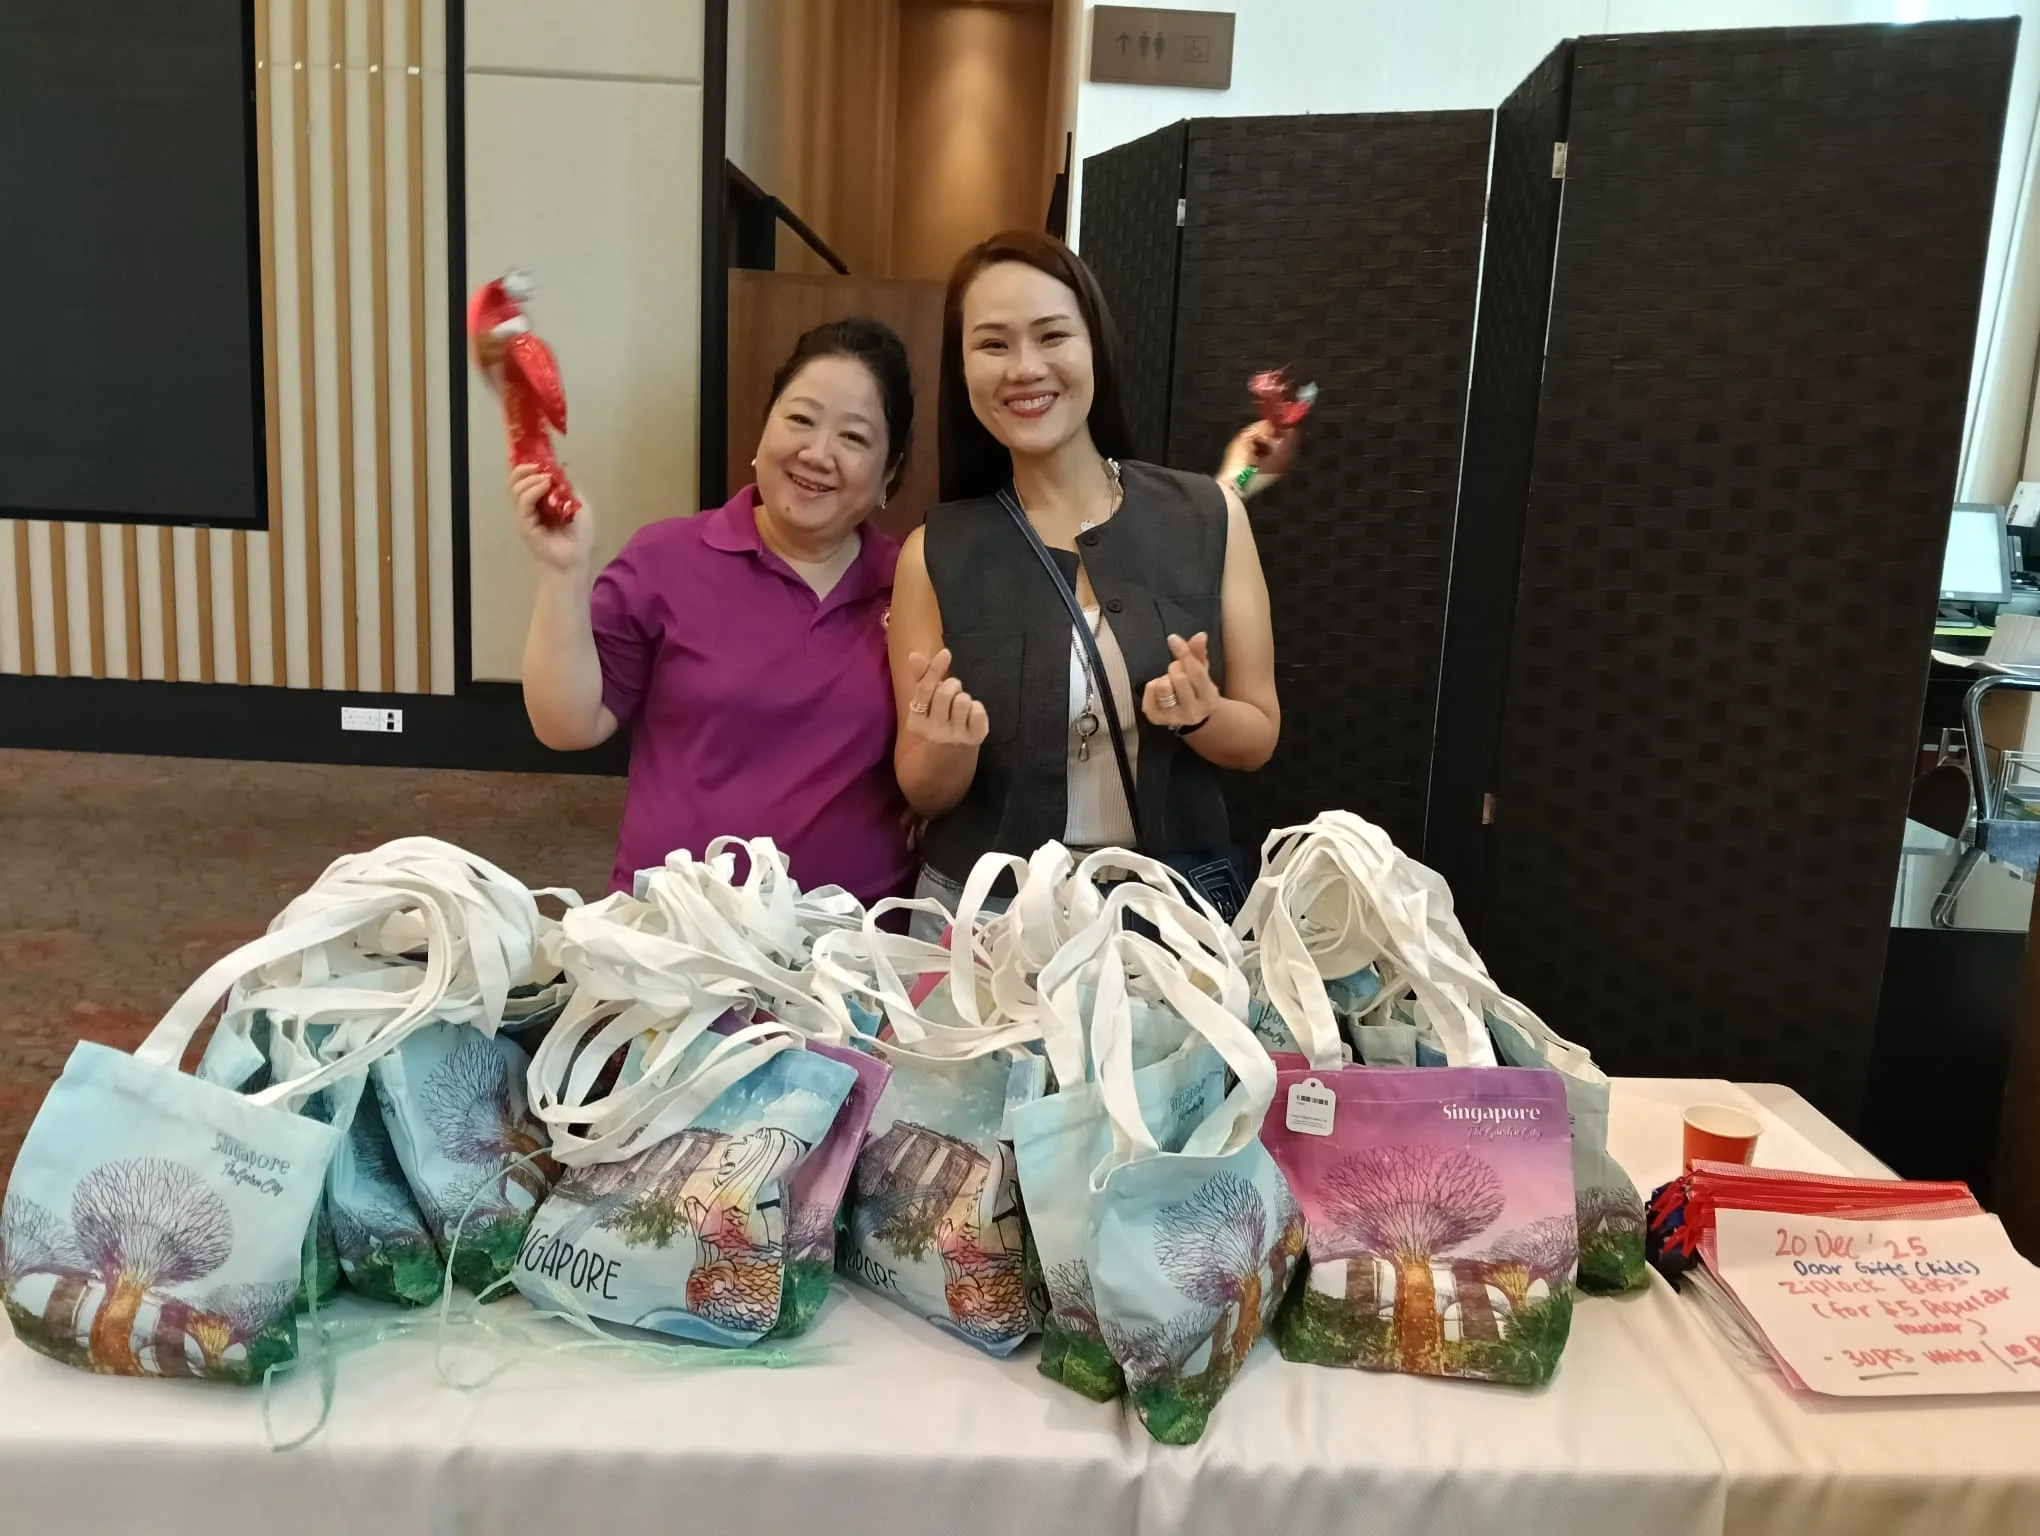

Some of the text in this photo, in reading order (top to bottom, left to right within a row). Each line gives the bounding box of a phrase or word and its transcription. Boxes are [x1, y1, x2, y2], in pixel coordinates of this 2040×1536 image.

[1442, 1103, 1541, 1124] Singapore
[210, 1132, 291, 1174] Singapore
[1775, 1228, 1807, 1257] 20
[1793, 1259, 1843, 1276] Door
[1855, 1260, 1909, 1276] Gifts
[1899, 1276, 1969, 1296] Bags
[1811, 1300, 1872, 1319] (for
[1876, 1299, 1920, 1319] $5
